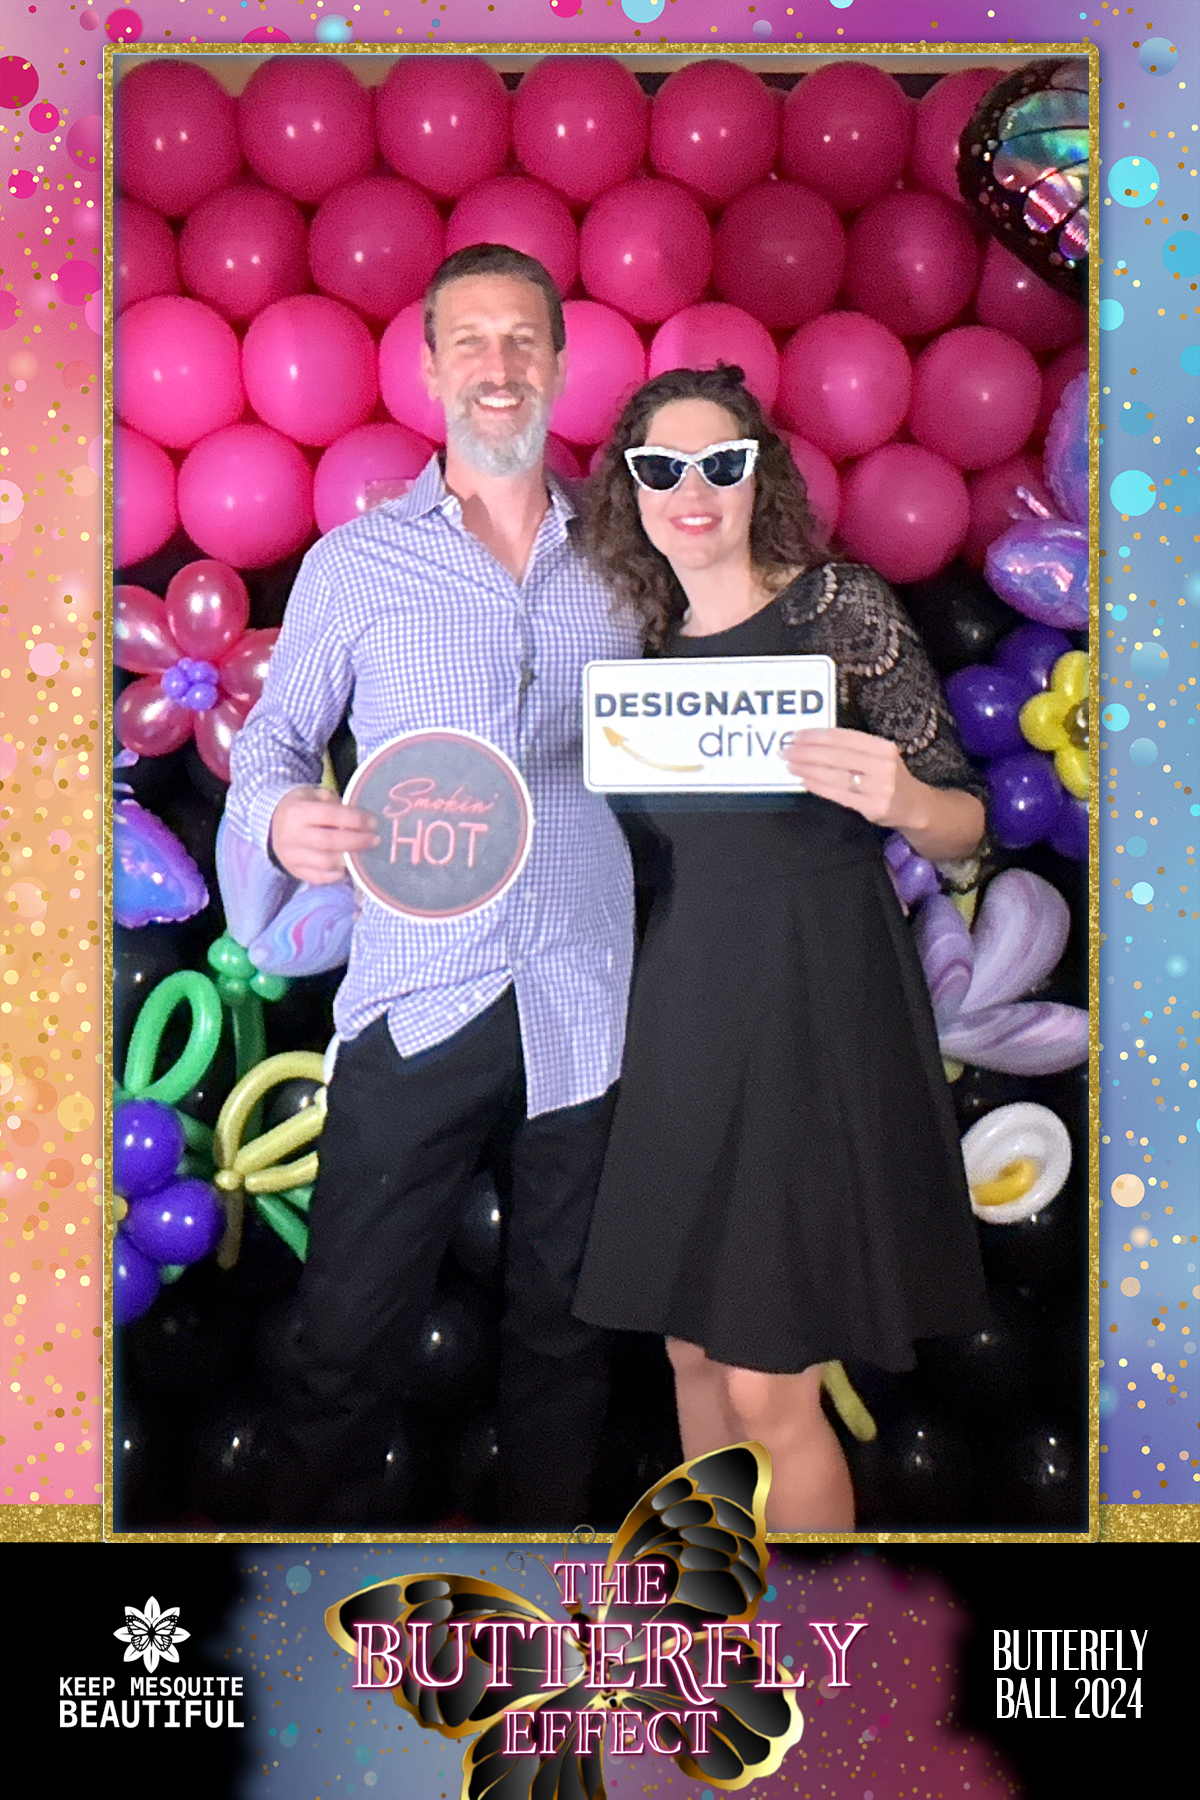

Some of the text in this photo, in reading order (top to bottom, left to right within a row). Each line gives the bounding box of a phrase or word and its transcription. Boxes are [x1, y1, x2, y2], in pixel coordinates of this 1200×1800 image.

[594, 689, 824, 718] DESIGNATED
[698, 723, 796, 758] drive
[390, 817, 488, 868] HOT
